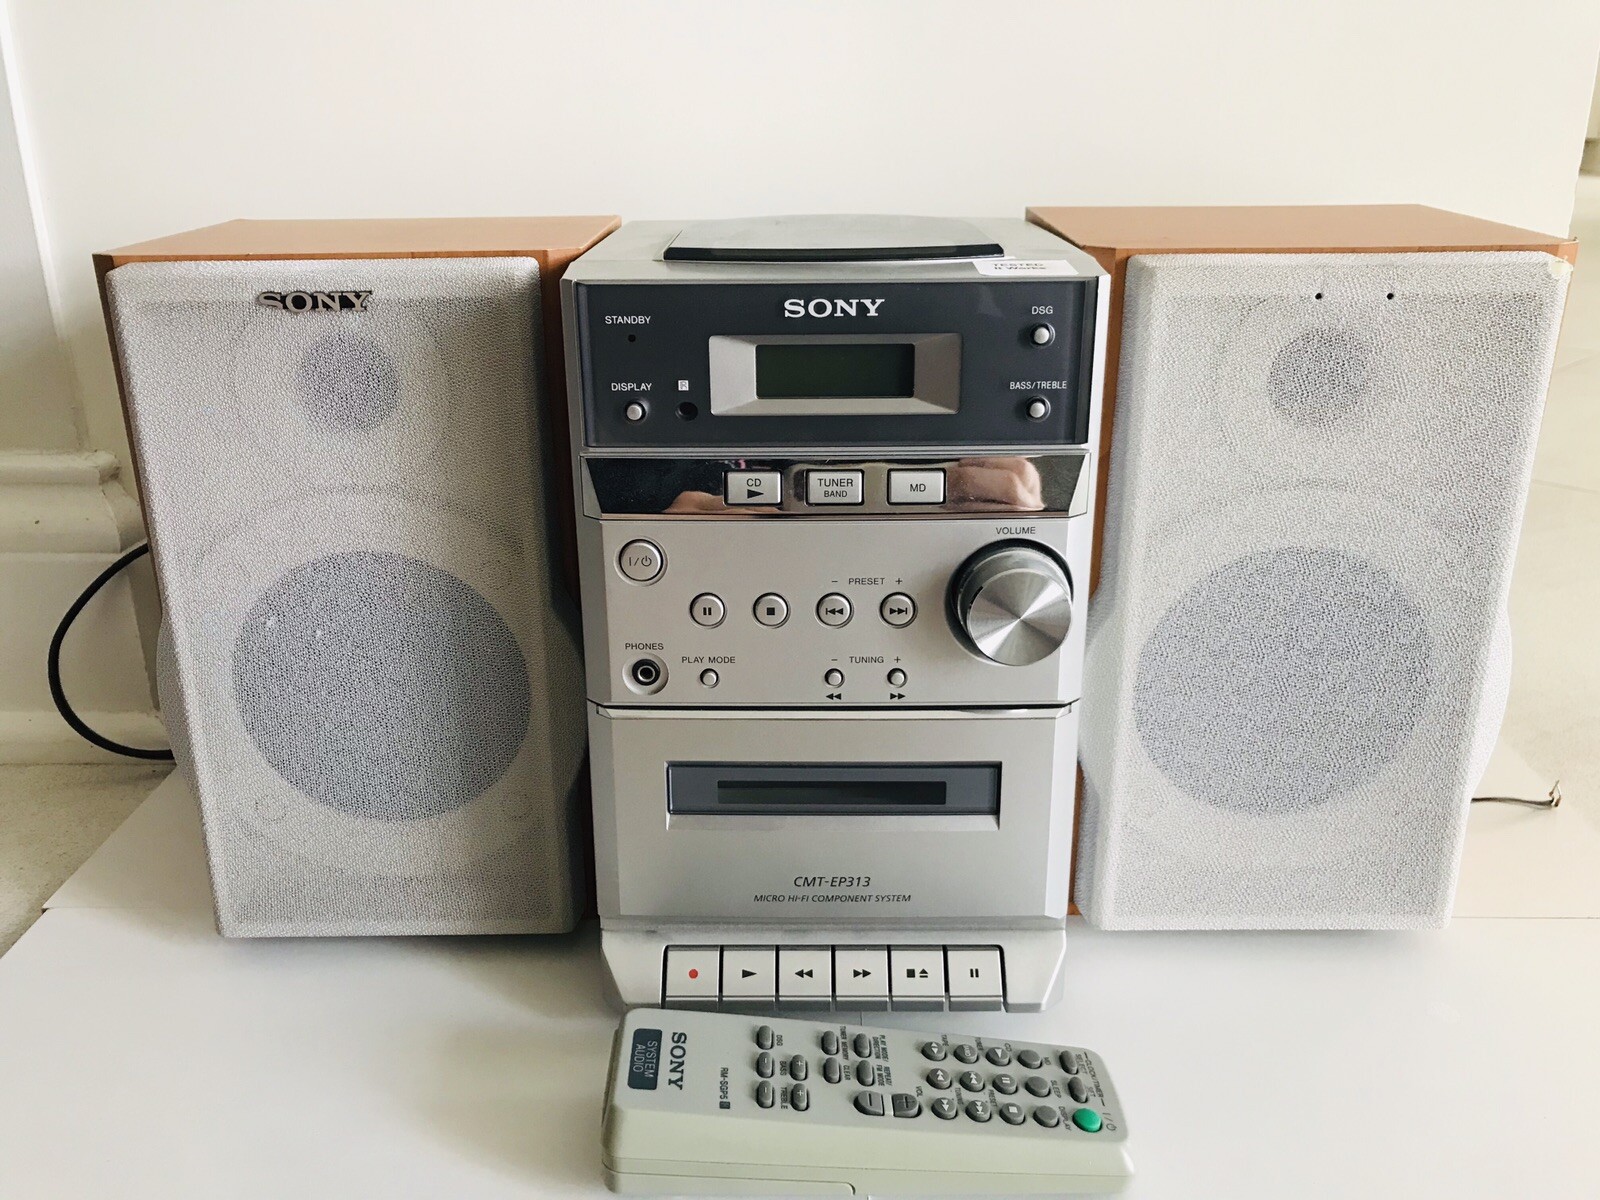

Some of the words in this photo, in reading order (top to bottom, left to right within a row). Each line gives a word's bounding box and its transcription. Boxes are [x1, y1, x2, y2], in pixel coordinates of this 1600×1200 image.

[257, 290, 373, 313] SONY
[783, 298, 885, 318] SONY
[1031, 306, 1054, 315] DSG
[604, 315, 651, 324] STANDBY
[611, 382, 652, 391] DISPLAY
[1009, 380, 1068, 390] BASS/TREBLE
[746, 478, 762, 487] CD
[817, 478, 854, 487] TUNER
[909, 483, 926, 492] MD
[823, 490, 848, 498] BAND
[995, 526, 1036, 535] VOLUME
[848, 577, 885, 586] PRESET
[624, 642, 664, 651] PHONES
[681, 656, 705, 664] PLAY
[708, 656, 736, 664] MODE
[849, 656, 885, 664] TUNING
[793, 876, 871, 888] CMT-EP313
[753, 894, 785, 902] MICRO
[787, 894, 809, 902] HI-FI
[811, 894, 873, 902] COMPONENT
[874, 894, 912, 902] SYSTEM
[1004, 1042, 1012, 1052] CD
[632, 1043, 646, 1073] AUDIO
[644, 1040, 658, 1078] SYSTEM
[668, 1032, 687, 1090] SONY
[779, 1060, 787, 1076] BASS
[843, 1064, 851, 1081] CLEAR
[719, 1067, 729, 1100] RM-SGP5
[1050, 1079, 1062, 1099] SLEEP
[780, 1087, 788, 1109] TREBLE
